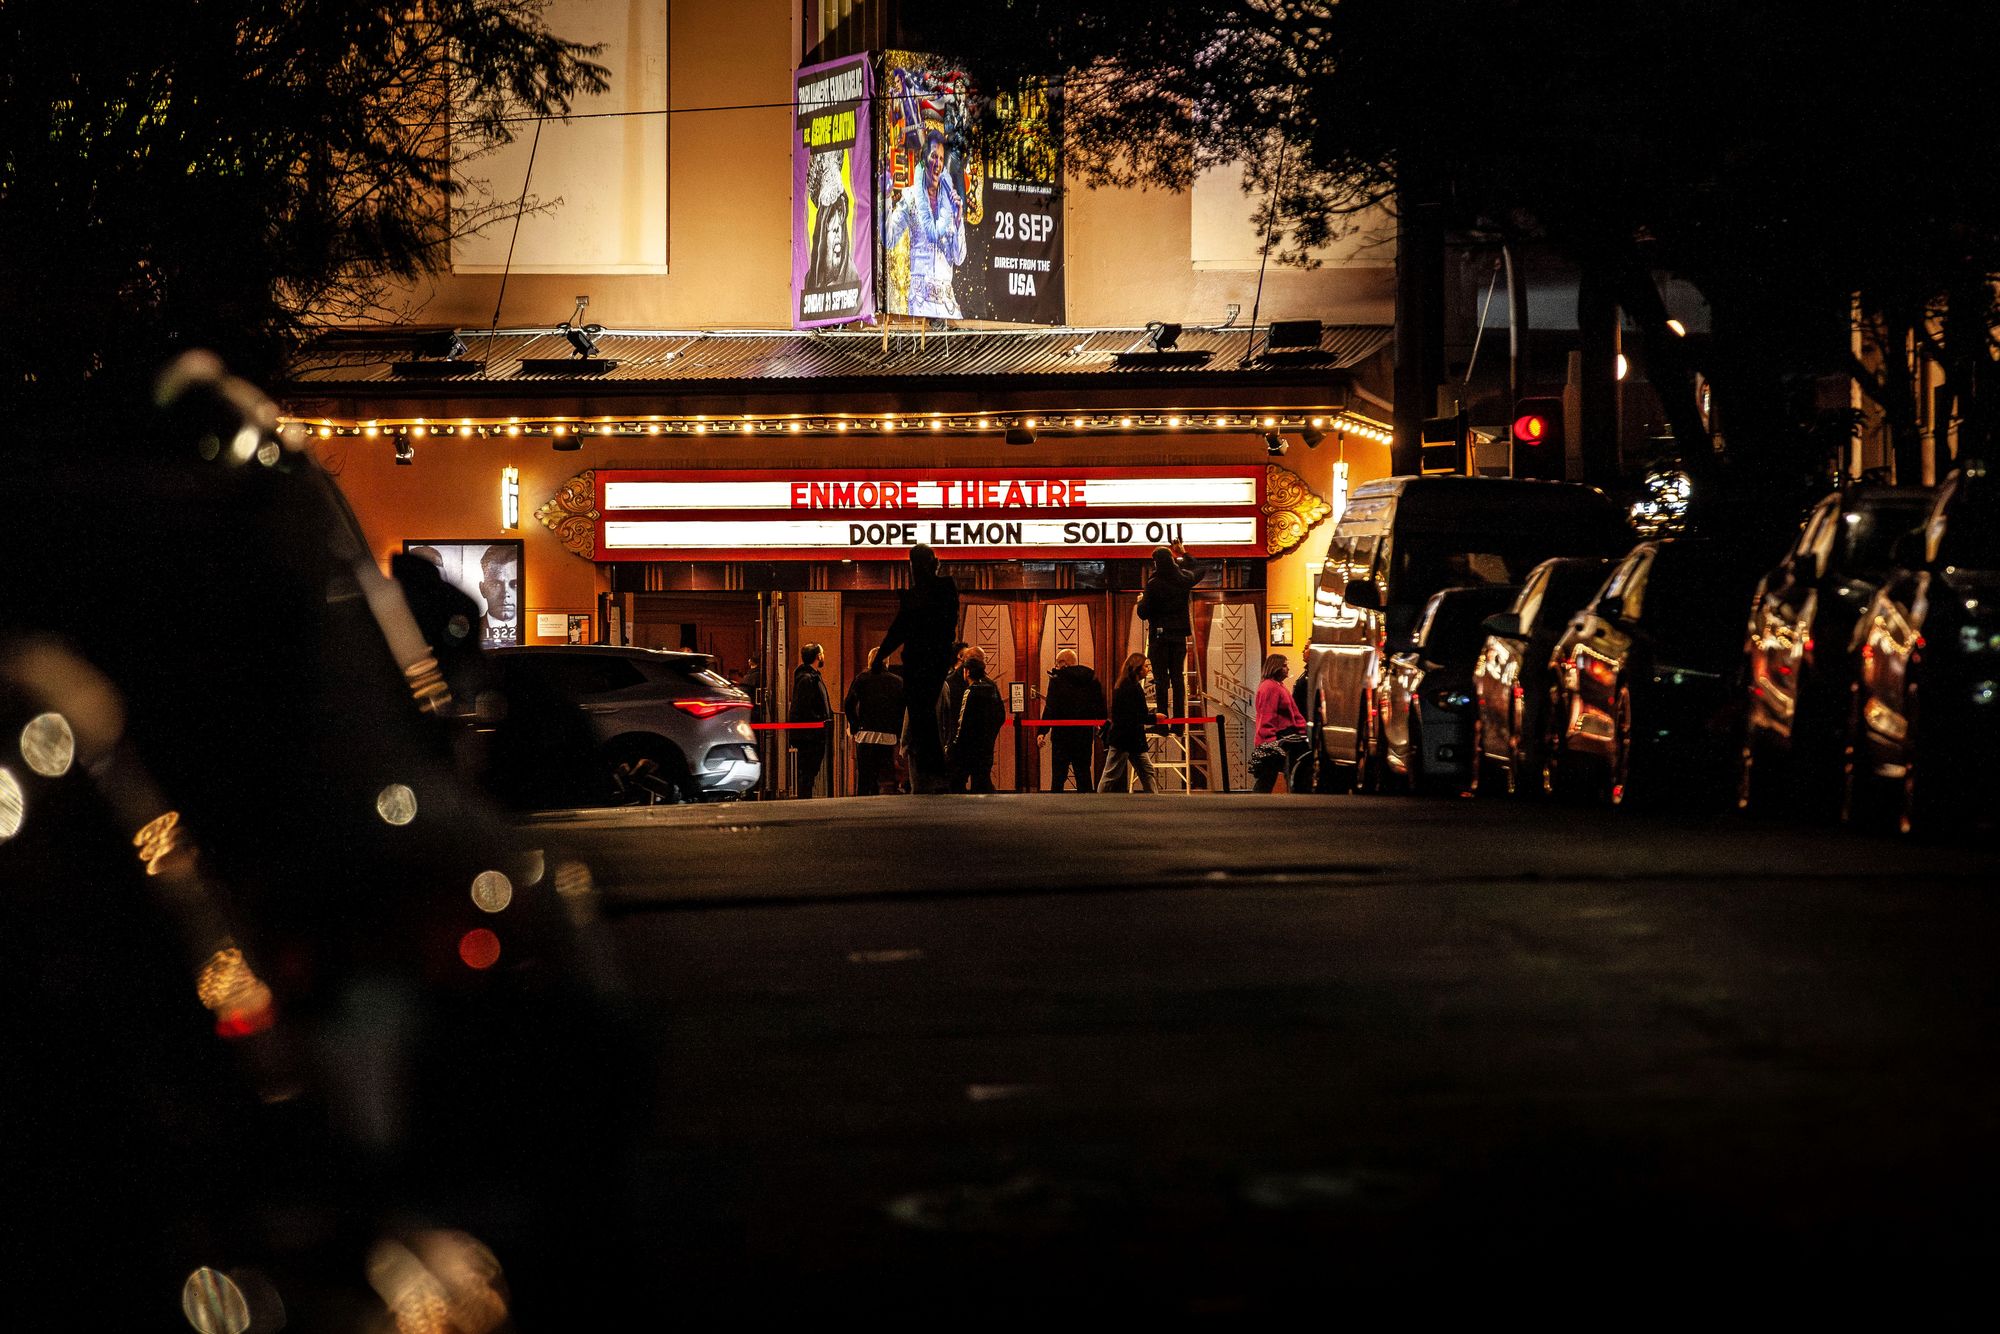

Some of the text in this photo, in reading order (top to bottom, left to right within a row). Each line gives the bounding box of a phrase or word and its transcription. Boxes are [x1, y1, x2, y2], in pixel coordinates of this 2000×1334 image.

[995, 211, 1053, 242] 28 SEP
[994, 256, 1051, 272] DIRECT FROM THE
[1009, 273, 1036, 296] USA
[803, 293, 825, 314] SUNDAY
[831, 288, 859, 311] SEPTEMBER
[791, 480, 1087, 509] ENMORE THEATRE
[849, 523, 918, 545] DOPE
[930, 522, 1022, 545] LEMON
[1064, 522, 1133, 544] SOLD
[486, 627, 517, 639] 1322
